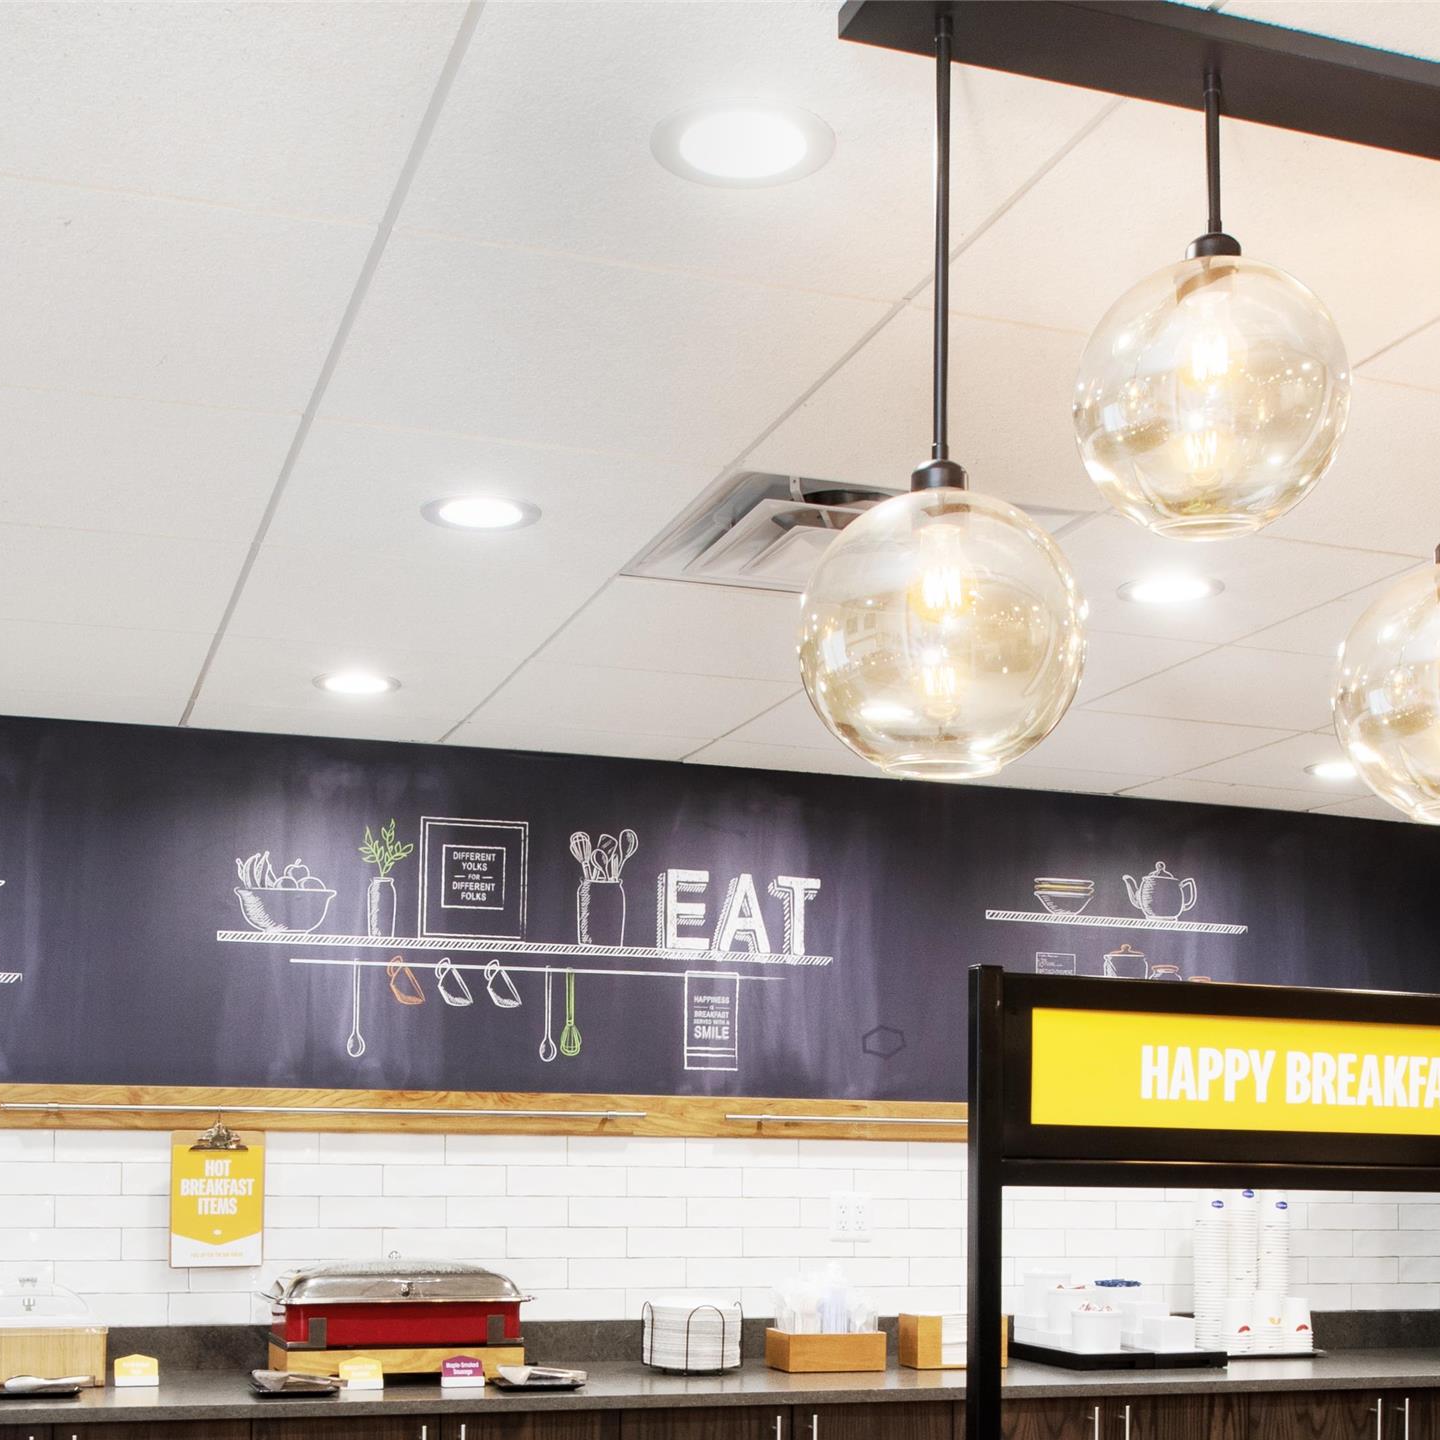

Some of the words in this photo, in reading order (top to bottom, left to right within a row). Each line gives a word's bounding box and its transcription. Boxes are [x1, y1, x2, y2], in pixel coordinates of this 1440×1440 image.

[453, 851, 496, 862] DIFFERENT
[462, 862, 488, 871] YOLKS
[452, 881, 496, 891] DIFFERENT
[461, 892, 487, 901] FOLKS
[656, 868, 822, 956] EAT
[693, 996, 730, 1004] HAPPINESS
[693, 1010, 730, 1018] BREAKFAST
[693, 1025, 730, 1040] SMILE
[1140, 1045, 1277, 1103] HAPPY
[205, 1159, 232, 1177] HOT
[180, 1178, 255, 1196] BREAKFAST
[197, 1197, 238, 1216] ITEMS
